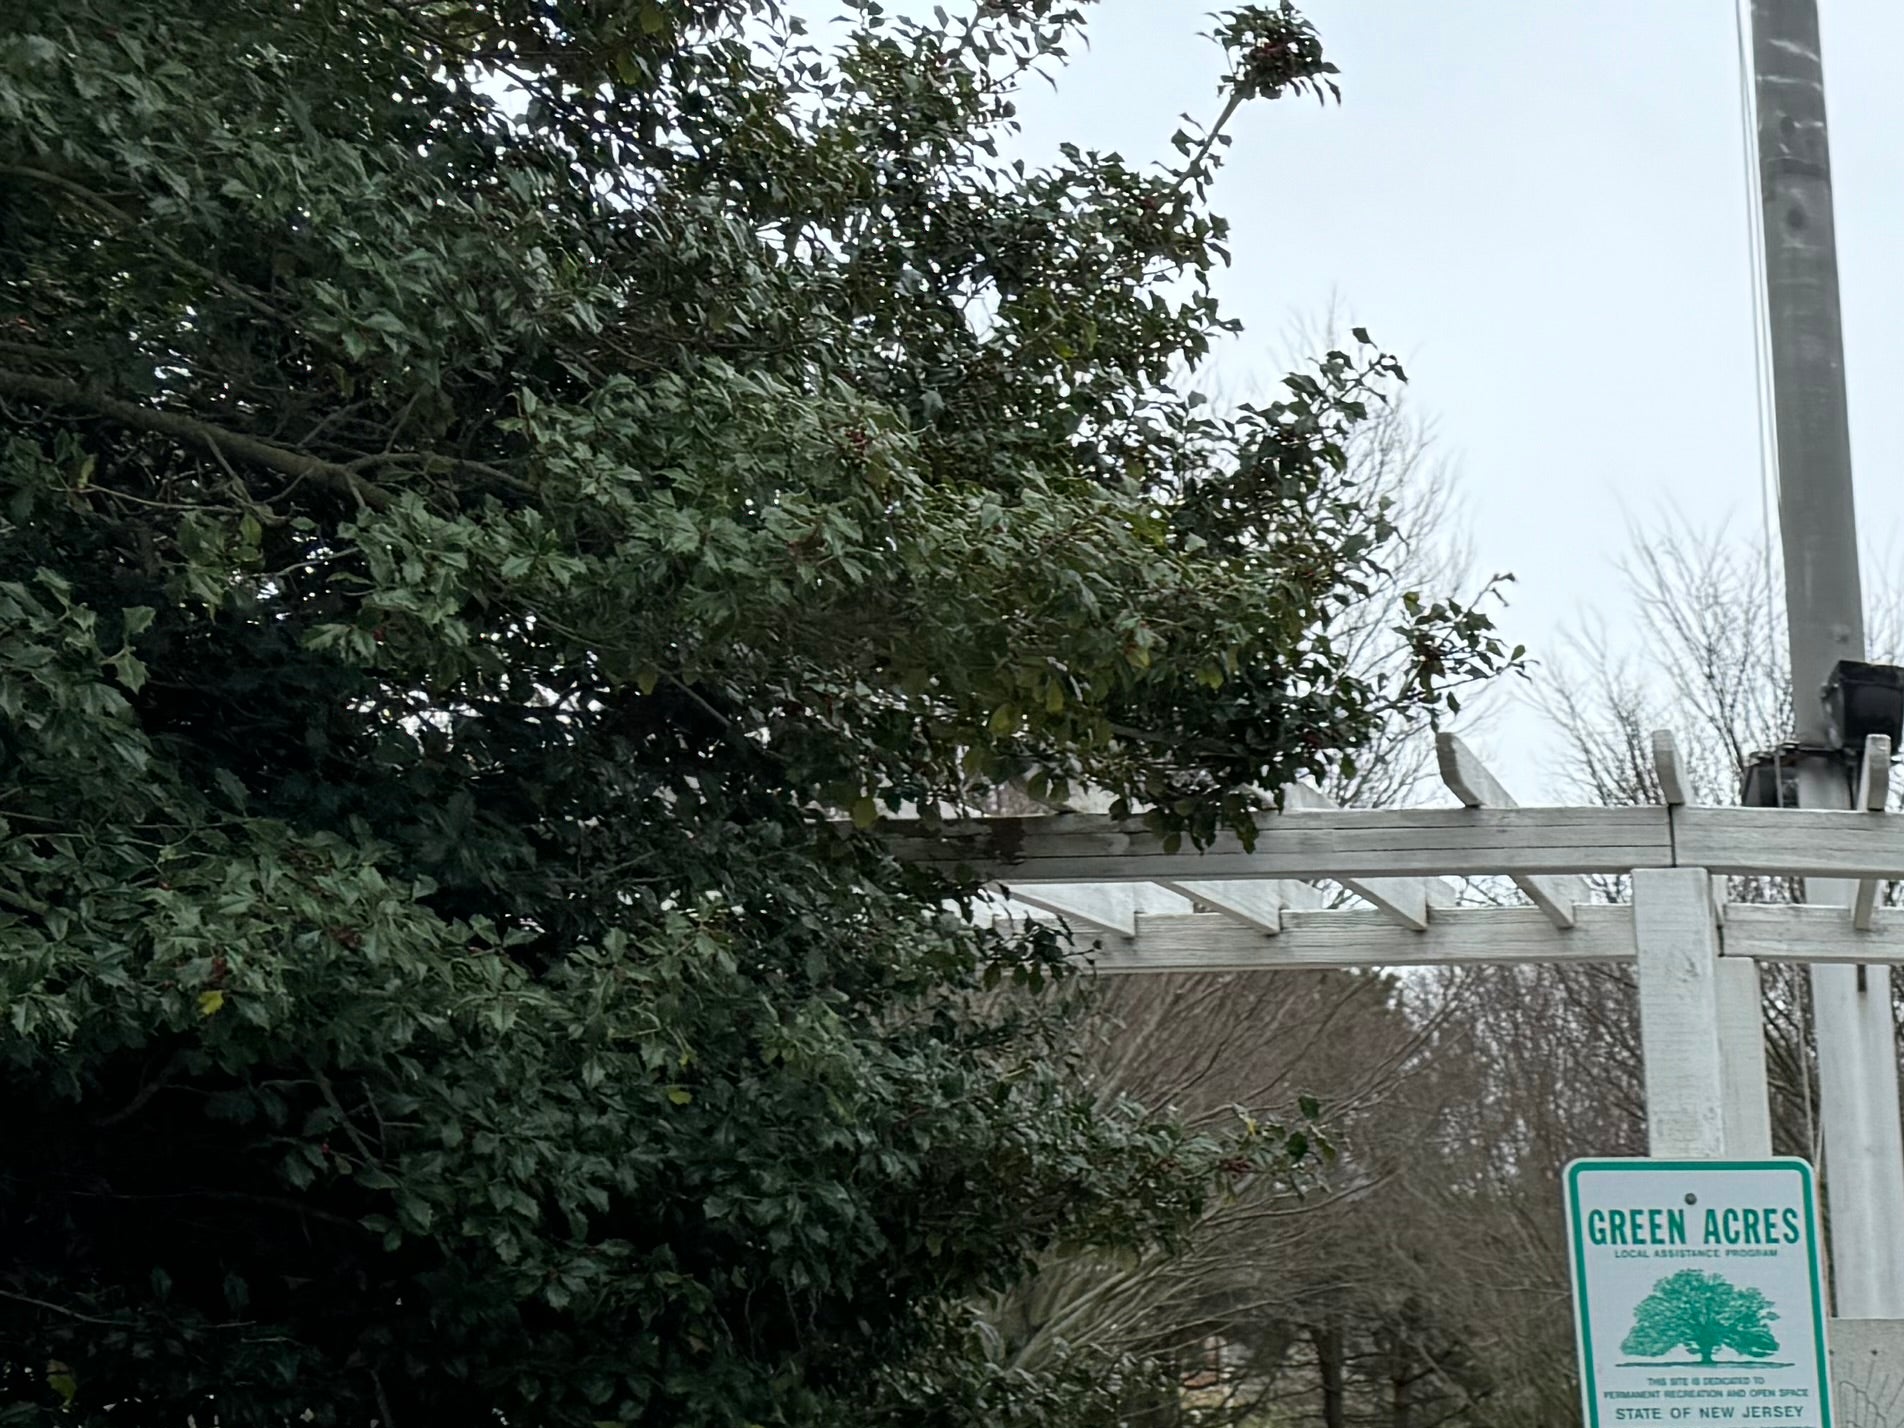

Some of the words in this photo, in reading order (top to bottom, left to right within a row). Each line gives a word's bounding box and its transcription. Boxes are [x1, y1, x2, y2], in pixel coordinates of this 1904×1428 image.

[1589, 1208, 1687, 1245] GREEN
[1703, 1208, 1799, 1244] ACRES
[1615, 1250, 1649, 1259] LOCAL
[1654, 1249, 1720, 1258] ASSISTANCE
[1725, 1249, 1777, 1257] PROGRAM
[1647, 1377, 1667, 1386] THIS
[1670, 1377, 1689, 1386] SITE
[1692, 1377, 1700, 1385] IS
[1703, 1377, 1750, 1385] DEDICATED
[1753, 1376, 1765, 1385] TO
[1604, 1390, 1660, 1399] PERMANENT
[1663, 1390, 1723, 1399] RECREATION
[1726, 1389, 1746, 1398] AND
[1750, 1389, 1776, 1398] OPEN
[1779, 1388, 1809, 1397] SPACE
[1616, 1408, 1662, 1420] STATE
[1670, 1408, 1691, 1419] OF
[1700, 1407, 1734, 1418] NEW
[1742, 1406, 1804, 1417] JERSEY
